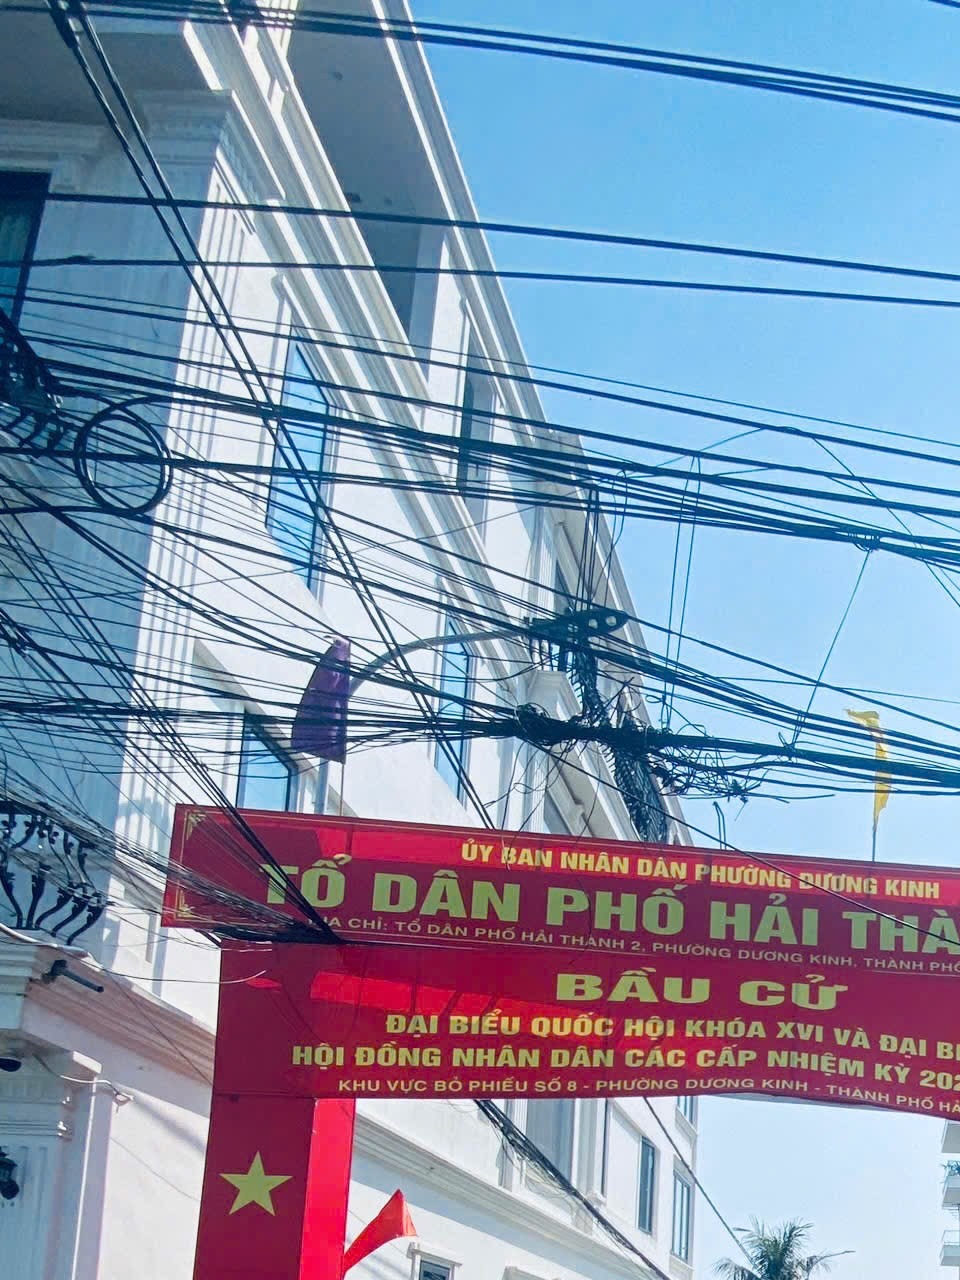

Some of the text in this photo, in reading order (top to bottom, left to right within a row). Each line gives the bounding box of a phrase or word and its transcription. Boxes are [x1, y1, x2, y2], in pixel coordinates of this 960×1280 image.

[461, 837, 940, 899] ỦY BAN NHÂN DÂN PHƯỜNG DƯƠNG KINH
[259, 853, 352, 908] TỔ
[371, 869, 520, 923] DÂN
[545, 884, 687, 935] PHỐ
[710, 893, 818, 947] HẢI
[348, 916, 388, 931] CHỈ:
[395, 918, 422, 933] TỔ
[427, 923, 467, 937] DÂN
[474, 926, 516, 941] PHỐ
[521, 929, 553, 943] HẢI
[560, 933, 625, 950] THÀNH
[652, 941, 731, 959] PHƯỜNG
[738, 948, 803, 963] DƯƠNG
[863, 957, 924, 971] THÀNH
[557, 968, 848, 1011] BẦU CỬ
[386, 1015, 437, 1038] ĐẠI
[450, 1008, 521, 1036] BIỂU
[531, 1011, 614, 1038] QUỐC
[624, 1016, 677, 1041] HỘI
[686, 1017, 766, 1039] KHÓA
[776, 1022, 823, 1043] XVI
[834, 1025, 871, 1050] VÀ
[879, 1035, 927, 1060] ĐẠI
[292, 1042, 344, 1069] HỘI
[354, 1039, 441, 1067] ĐỒNG
[452, 1044, 540, 1067] NHÂN
[550, 1045, 614, 1068] DÂN
[625, 1045, 685, 1068] CÁC
[696, 1043, 757, 1069] CẤP
[767, 1050, 864, 1079] NHIỆM
[874, 1060, 911, 1084] KỲ
[338, 1080, 381, 1092] KHU
[386, 1078, 428, 1093] VỰC
[434, 1075, 463, 1092] BỎ
[469, 1076, 528, 1092] PHIẾU
[535, 1075, 562, 1092] SỐ
[567, 1080, 577, 1092] 8
[596, 1077, 679, 1091] PHƯỜNG
[685, 1077, 754, 1089] DƯƠNG
[762, 1079, 808, 1092] KINH
[826, 1084, 889, 1103] THÀNH
[896, 1094, 934, 1110] PHỐ
